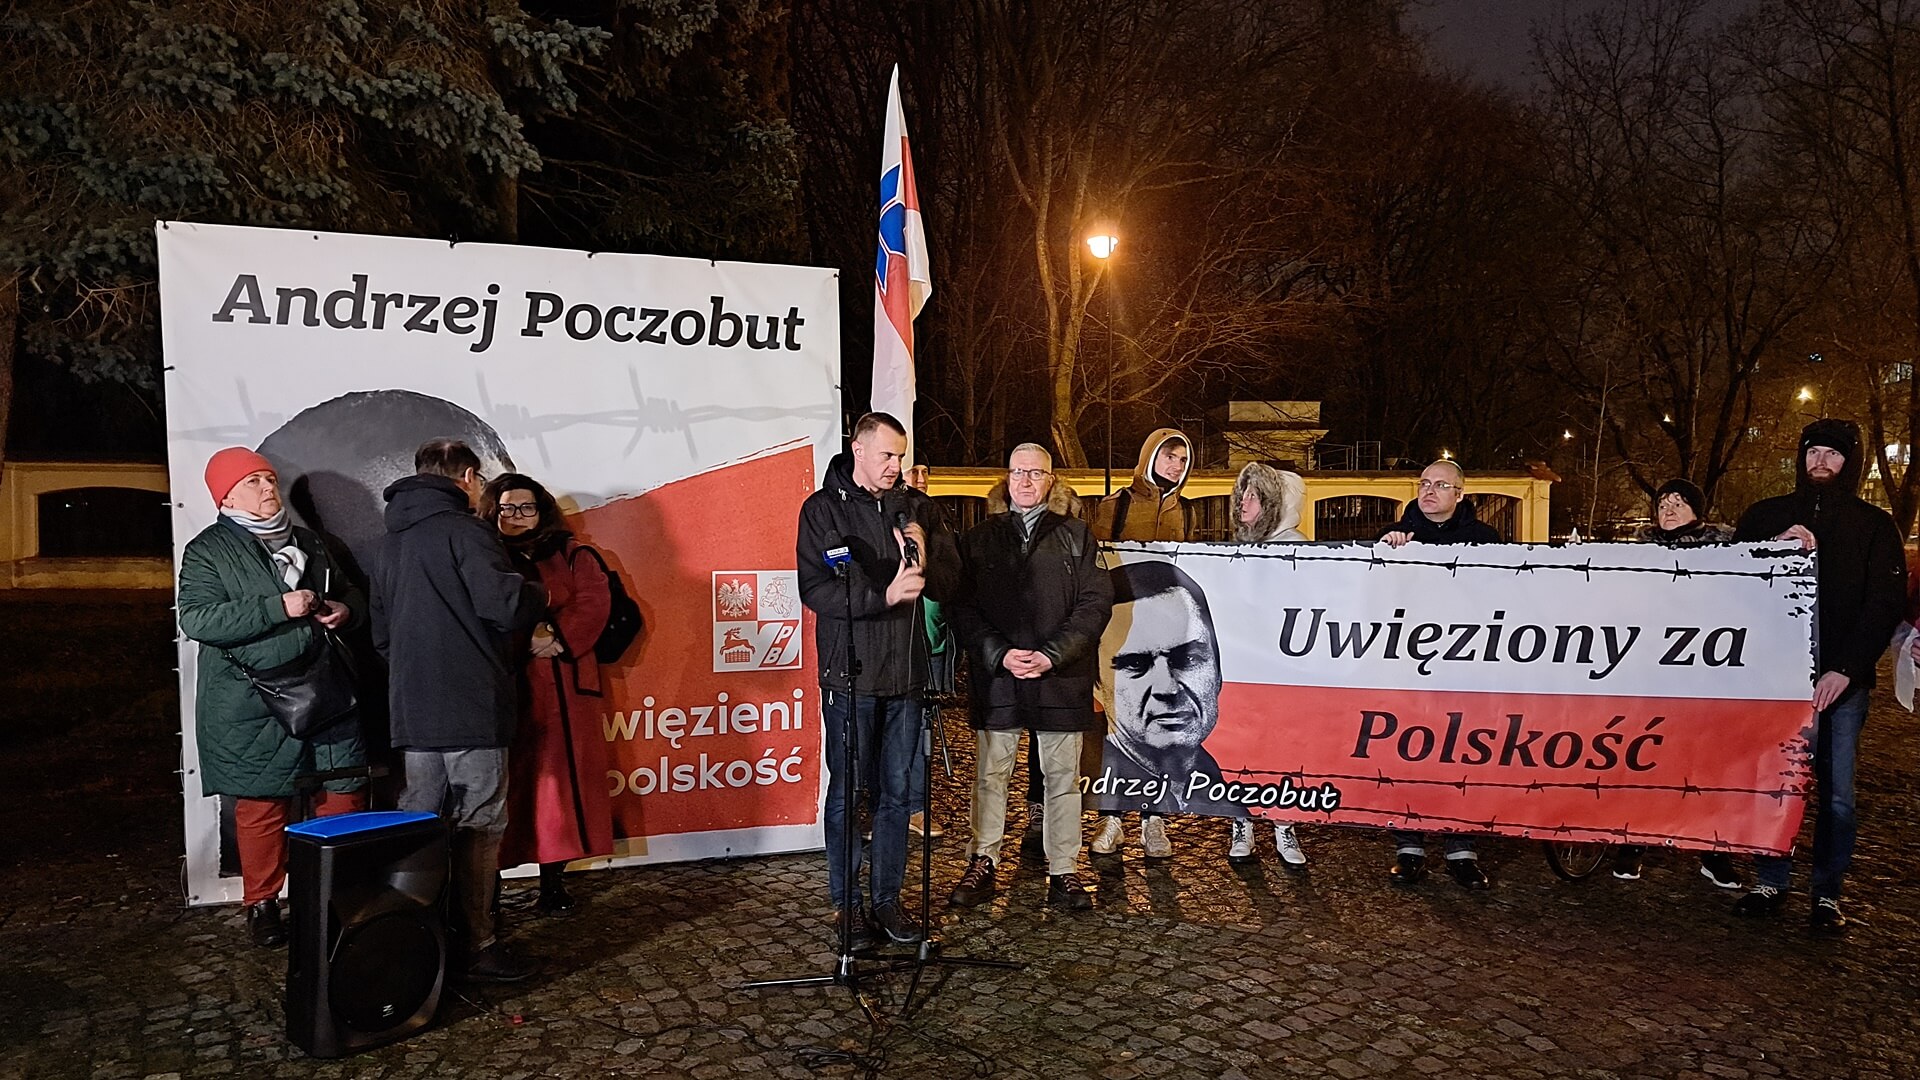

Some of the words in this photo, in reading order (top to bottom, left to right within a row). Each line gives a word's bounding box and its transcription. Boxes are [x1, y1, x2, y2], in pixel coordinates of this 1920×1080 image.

[212, 273, 501, 353] Andrzej
[520, 290, 805, 351] Poczobut
[1279, 608, 1641, 680] Uwięziony
[1658, 627, 1748, 667] za
[1350, 710, 1666, 772] Polskość
[1079, 766, 1169, 806] ndrzej
[1185, 770, 1338, 810] Poczobut
